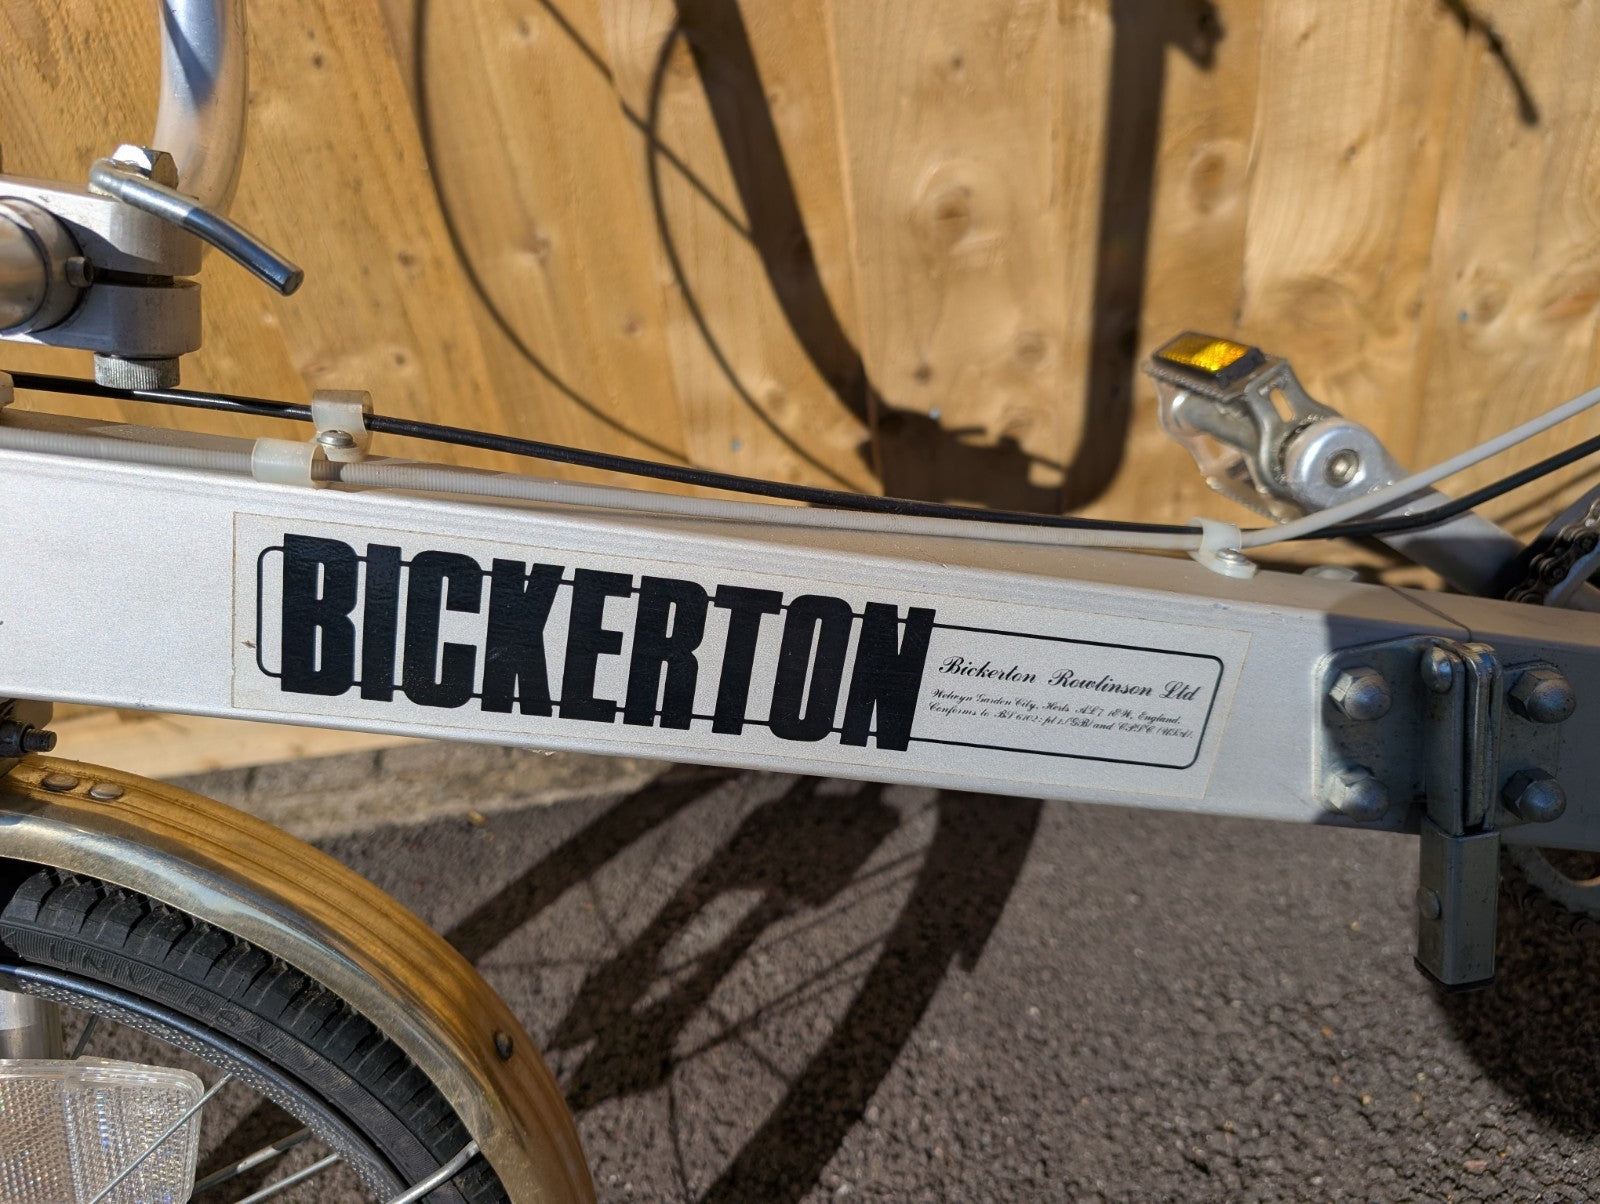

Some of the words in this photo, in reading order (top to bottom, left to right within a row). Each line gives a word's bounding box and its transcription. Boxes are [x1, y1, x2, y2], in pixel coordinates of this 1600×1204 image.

[281, 533, 936, 752] BICKERTON
[938, 655, 1037, 684] Bickerton
[1047, 668, 1153, 697] Rowlinson
[1159, 680, 1202, 701] Ltd
[929, 701, 976, 717] Conforms
[980, 708, 990, 717] to
[1092, 721, 1116, 731] and
[931, 688, 973, 704] Welwyn
[976, 693, 1012, 706] Garden
[1042, 701, 1070, 713] Herts
